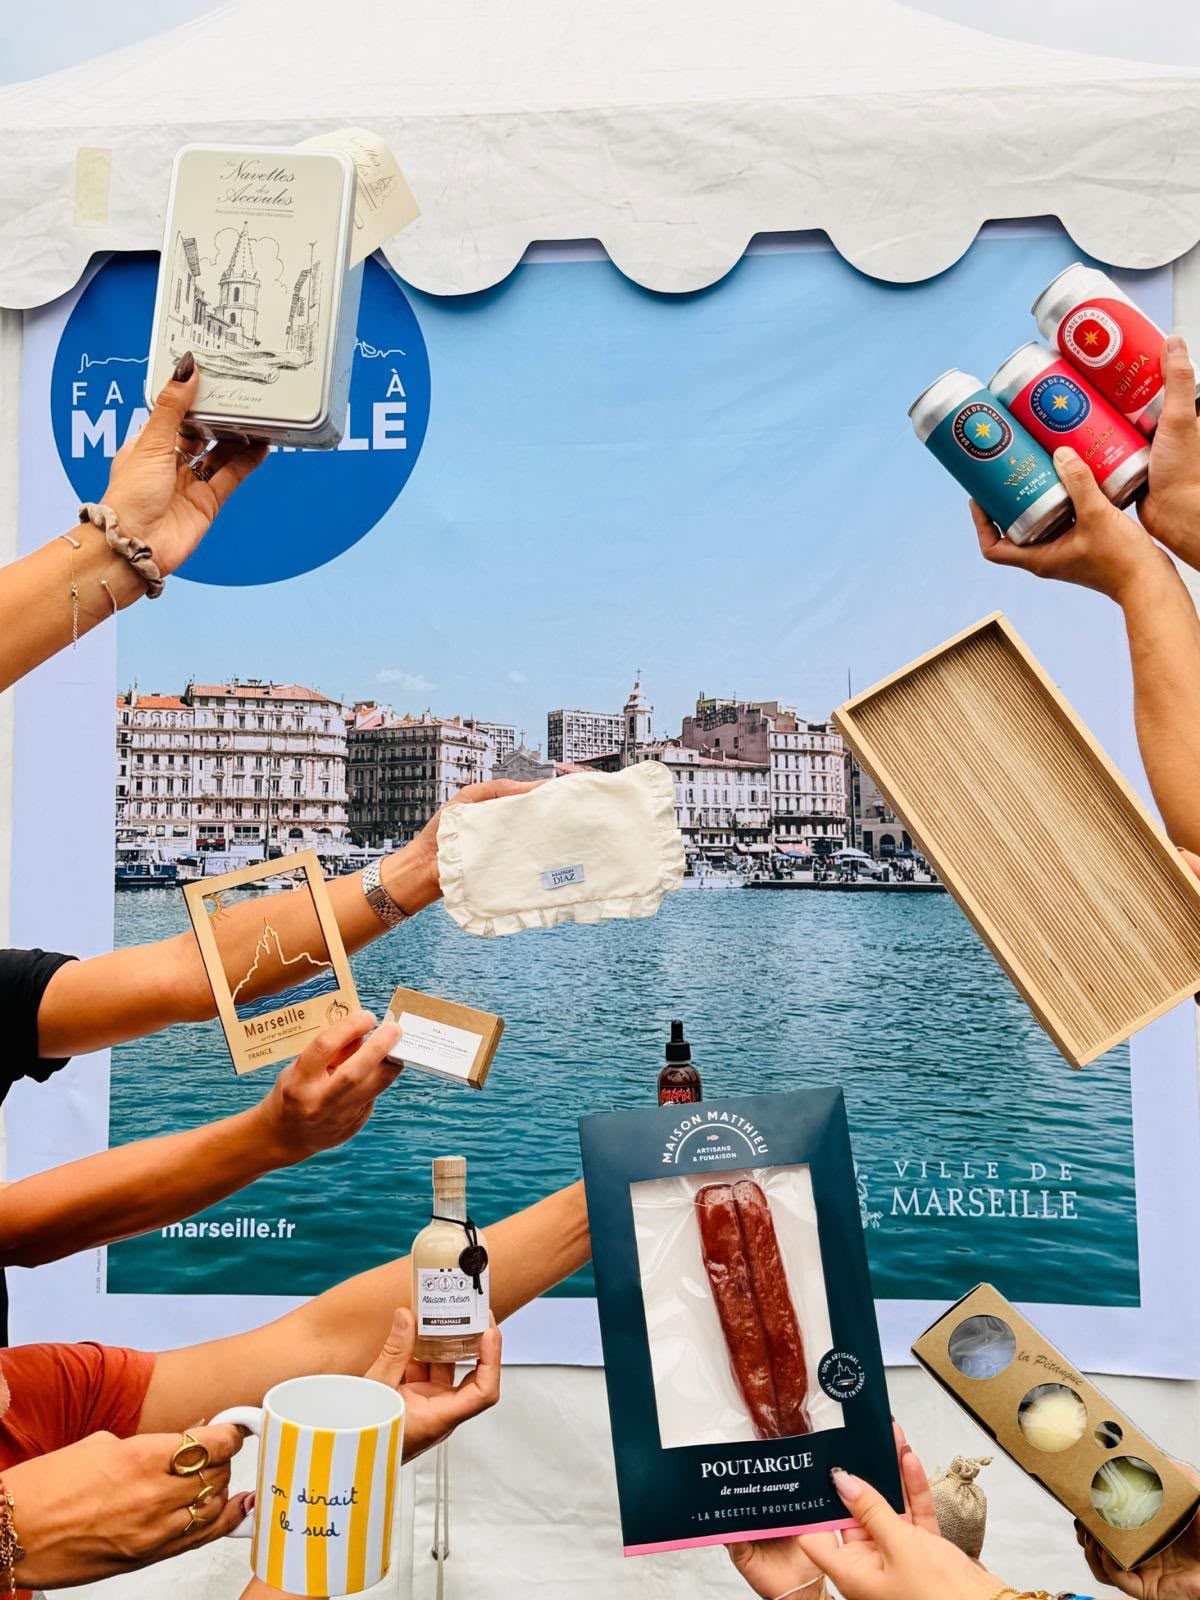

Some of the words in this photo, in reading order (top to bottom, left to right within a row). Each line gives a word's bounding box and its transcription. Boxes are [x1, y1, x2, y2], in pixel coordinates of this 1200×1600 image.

[220, 160, 295, 182] Navettes
[217, 183, 293, 206] Accoules
[386, 368, 406, 397] À
[1032, 381, 1049, 420] BRASSERIE
[1047, 377, 1058, 386] DE
[1059, 377, 1078, 393] MARS
[956, 409, 972, 447] BRASSERIE
[970, 405, 981, 414] DE
[553, 873, 576, 885] DIAZ
[244, 1008, 305, 1038] Marseille
[248, 1047, 273, 1060] FRANCE
[662, 1114, 702, 1163] MAISON
[707, 1111, 769, 1154] MATTHIEU
[696, 1145, 731, 1154] ARTISANS
[699, 1152, 737, 1161] FUMAISON
[894, 1160, 999, 1179] VILLE
[1031, 1162, 1072, 1181] DE
[890, 1187, 1078, 1219] MARSEILLE
[161, 1217, 296, 1238] marseille.fr
[1017, 1351, 1030, 1362] la
[1033, 1355, 1083, 1385] Pétanque
[700, 1452, 813, 1478] POUTARGUE
[271, 1484, 287, 1499] on
[297, 1486, 359, 1506] dirait
[720, 1486, 732, 1496] de
[733, 1484, 761, 1494] mulet
[762, 1481, 800, 1492] sauvage
[279, 1511, 294, 1532] le
[301, 1522, 341, 1537] sud
[714, 1507, 758, 1519] RECETTE
